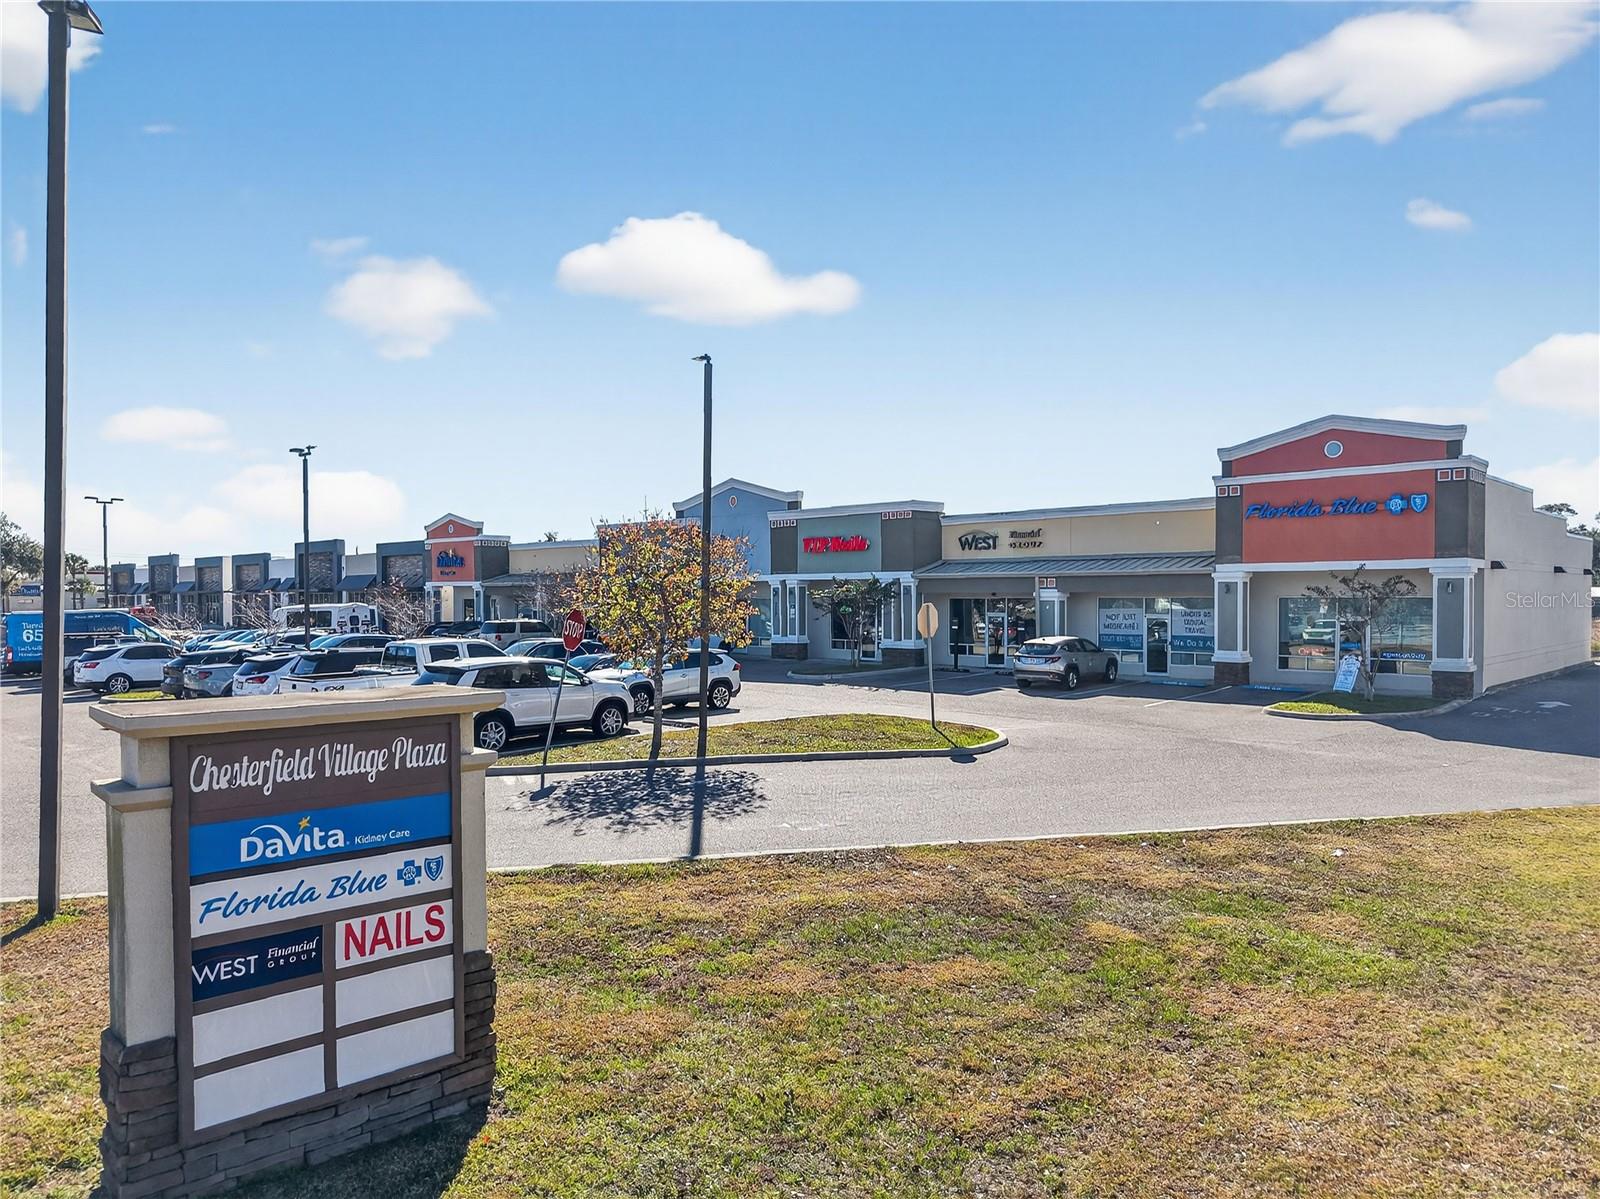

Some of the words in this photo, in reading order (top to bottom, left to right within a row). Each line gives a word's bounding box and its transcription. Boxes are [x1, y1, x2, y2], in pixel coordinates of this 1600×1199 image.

[1245, 500, 1324, 520] Florida
[1329, 497, 1378, 516] Blue
[958, 534, 999, 551] WEST
[565, 620, 583, 638] STOP
[189, 747, 316, 796] Chesterfield
[318, 742, 389, 783] Village
[392, 736, 447, 769] Plaza
[240, 824, 344, 862] DaVita
[354, 834, 387, 846] Kidney
[389, 829, 410, 841] Care
[198, 880, 321, 924] Florida
[326, 870, 388, 899] Blue
[343, 904, 446, 960] NAILS
[191, 955, 258, 984] WEST
[267, 936, 320, 959] Financial
[267, 951, 317, 968] GROUP
